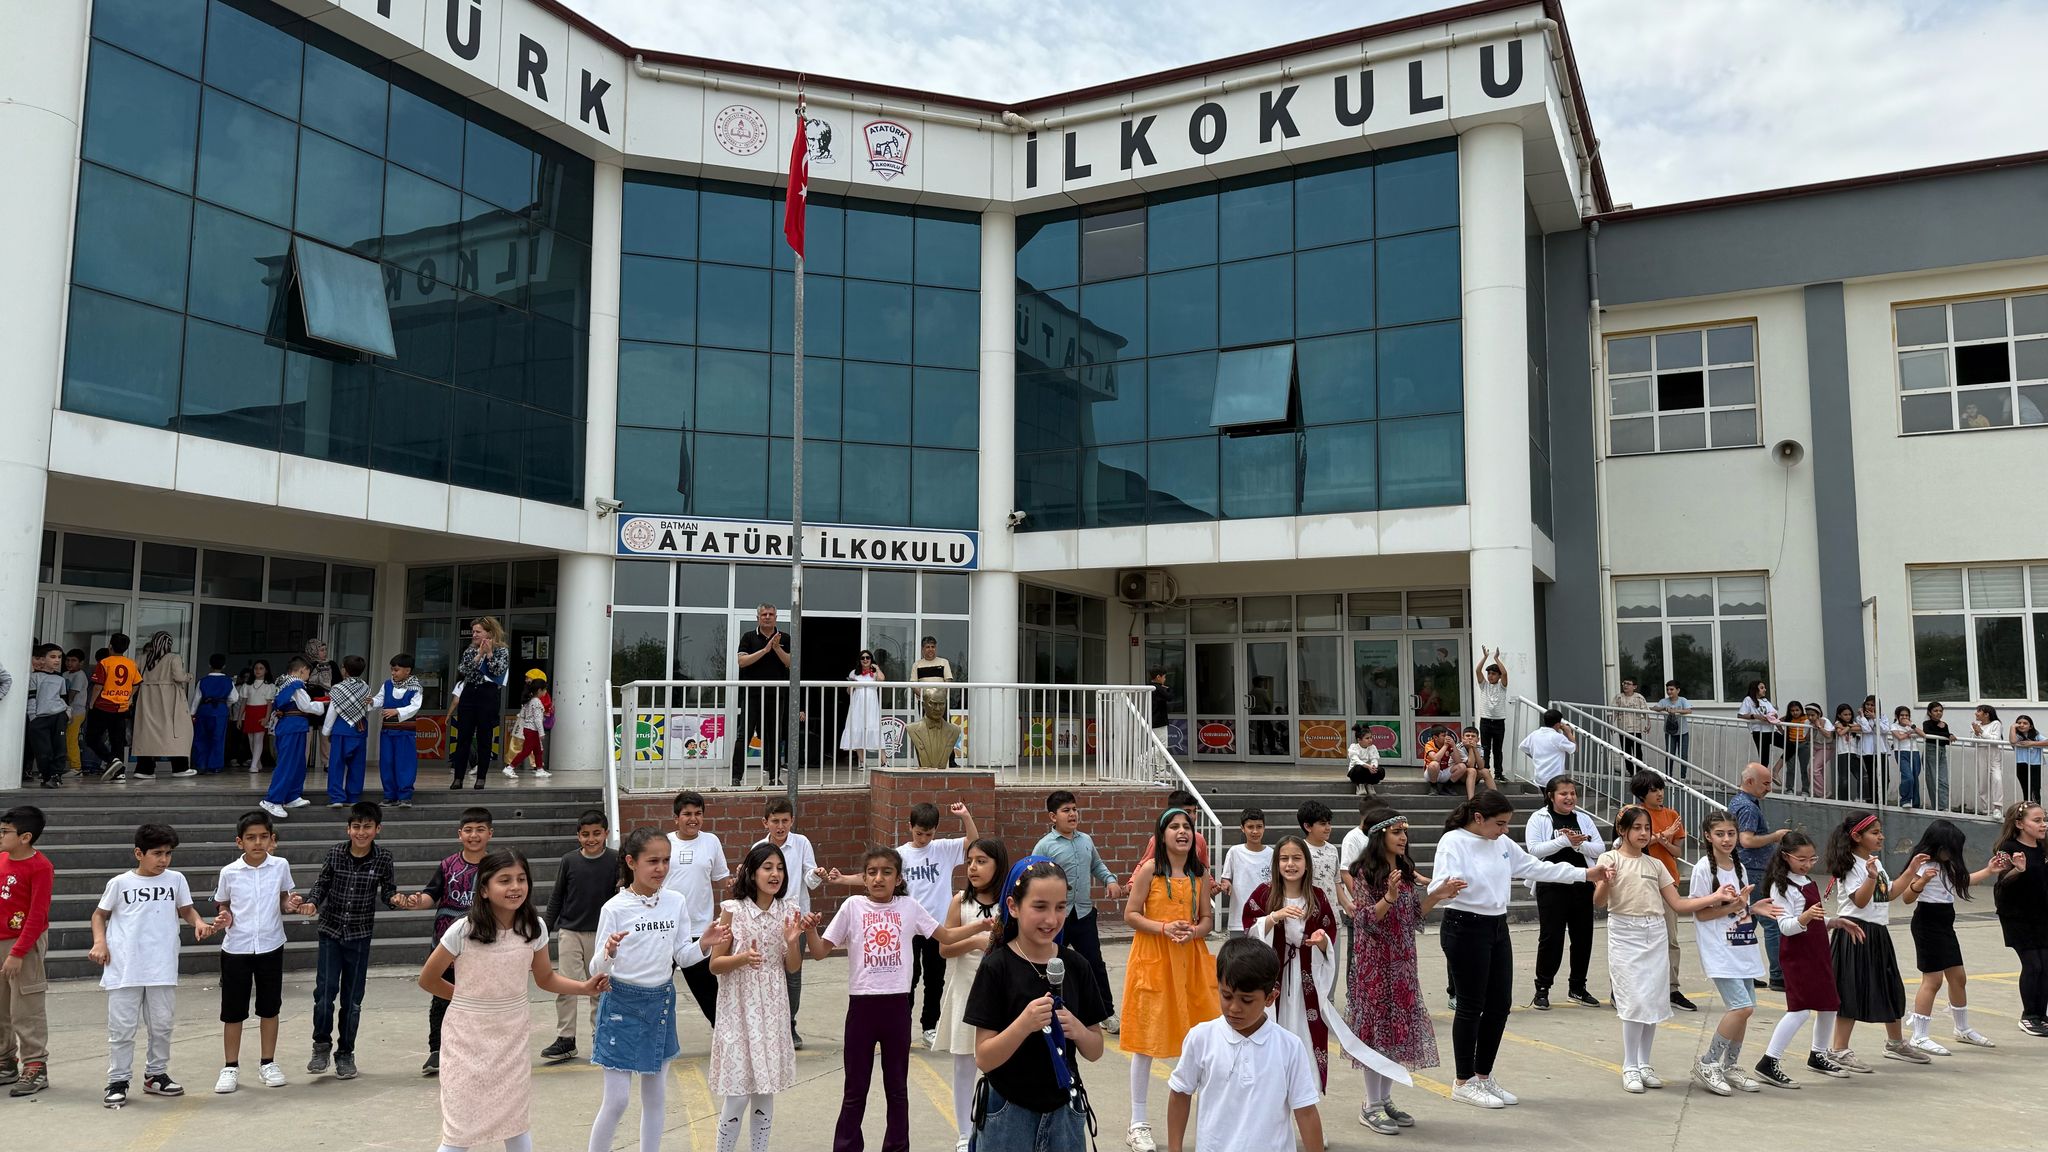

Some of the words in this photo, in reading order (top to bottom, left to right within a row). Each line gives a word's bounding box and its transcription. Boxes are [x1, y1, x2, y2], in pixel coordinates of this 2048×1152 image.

[377, 0, 611, 134] ÜRK
[1026, 39, 1523, 188] İLKOKULU
[869, 125, 907, 139] ATATÜRK
[875, 161, 901, 170] İLKOKULU
[660, 521, 699, 531] BATMAN
[658, 527, 804, 557] ATATÜRK
[820, 531, 965, 563] İLKOKULU
[114, 664, 129, 687] 9
[122, 886, 175, 905] USPA
[634, 920, 675, 932] SPARKLE
[863, 912, 883, 929] FEEL
[884, 911, 902, 927] THE
[864, 950, 902, 969] POWER
